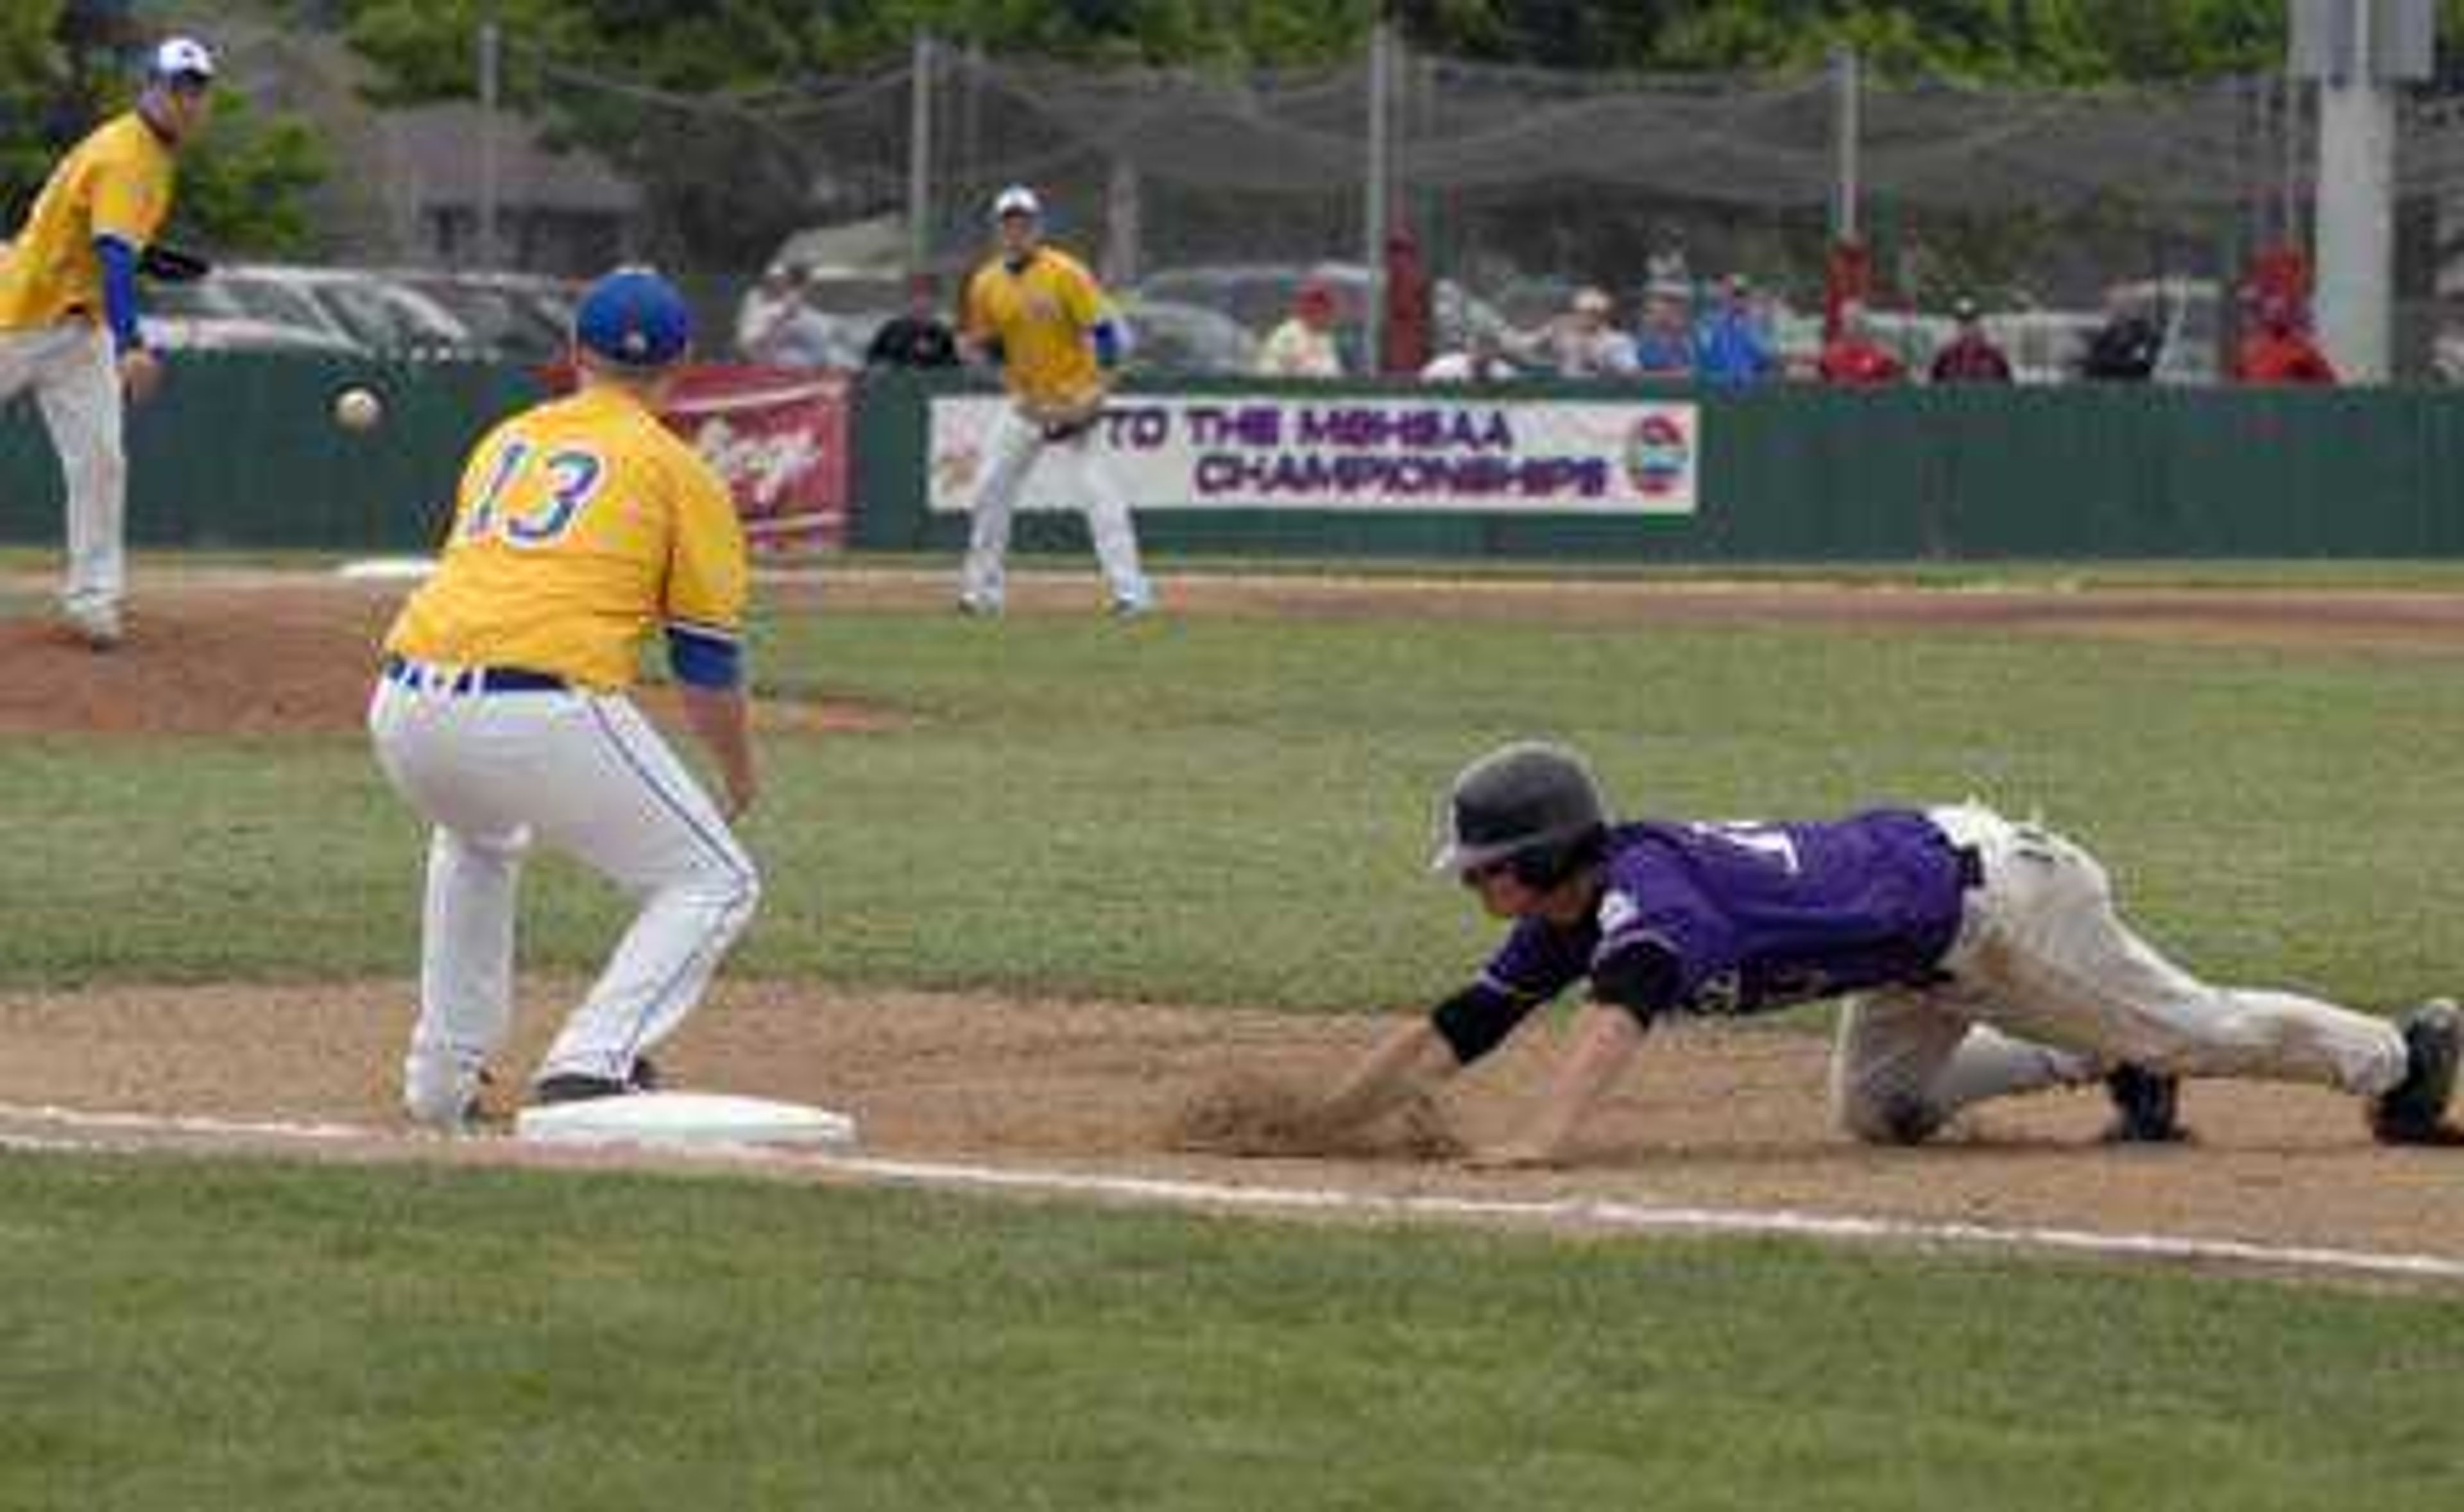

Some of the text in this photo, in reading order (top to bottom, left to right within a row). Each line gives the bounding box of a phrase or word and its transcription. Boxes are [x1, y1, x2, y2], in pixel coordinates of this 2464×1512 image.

[1100, 408, 1169, 448] TO
[1185, 408, 1282, 447] THE
[466, 433, 605, 549] 13
[1195, 454, 1608, 498] CHAMPIONSHIPS
